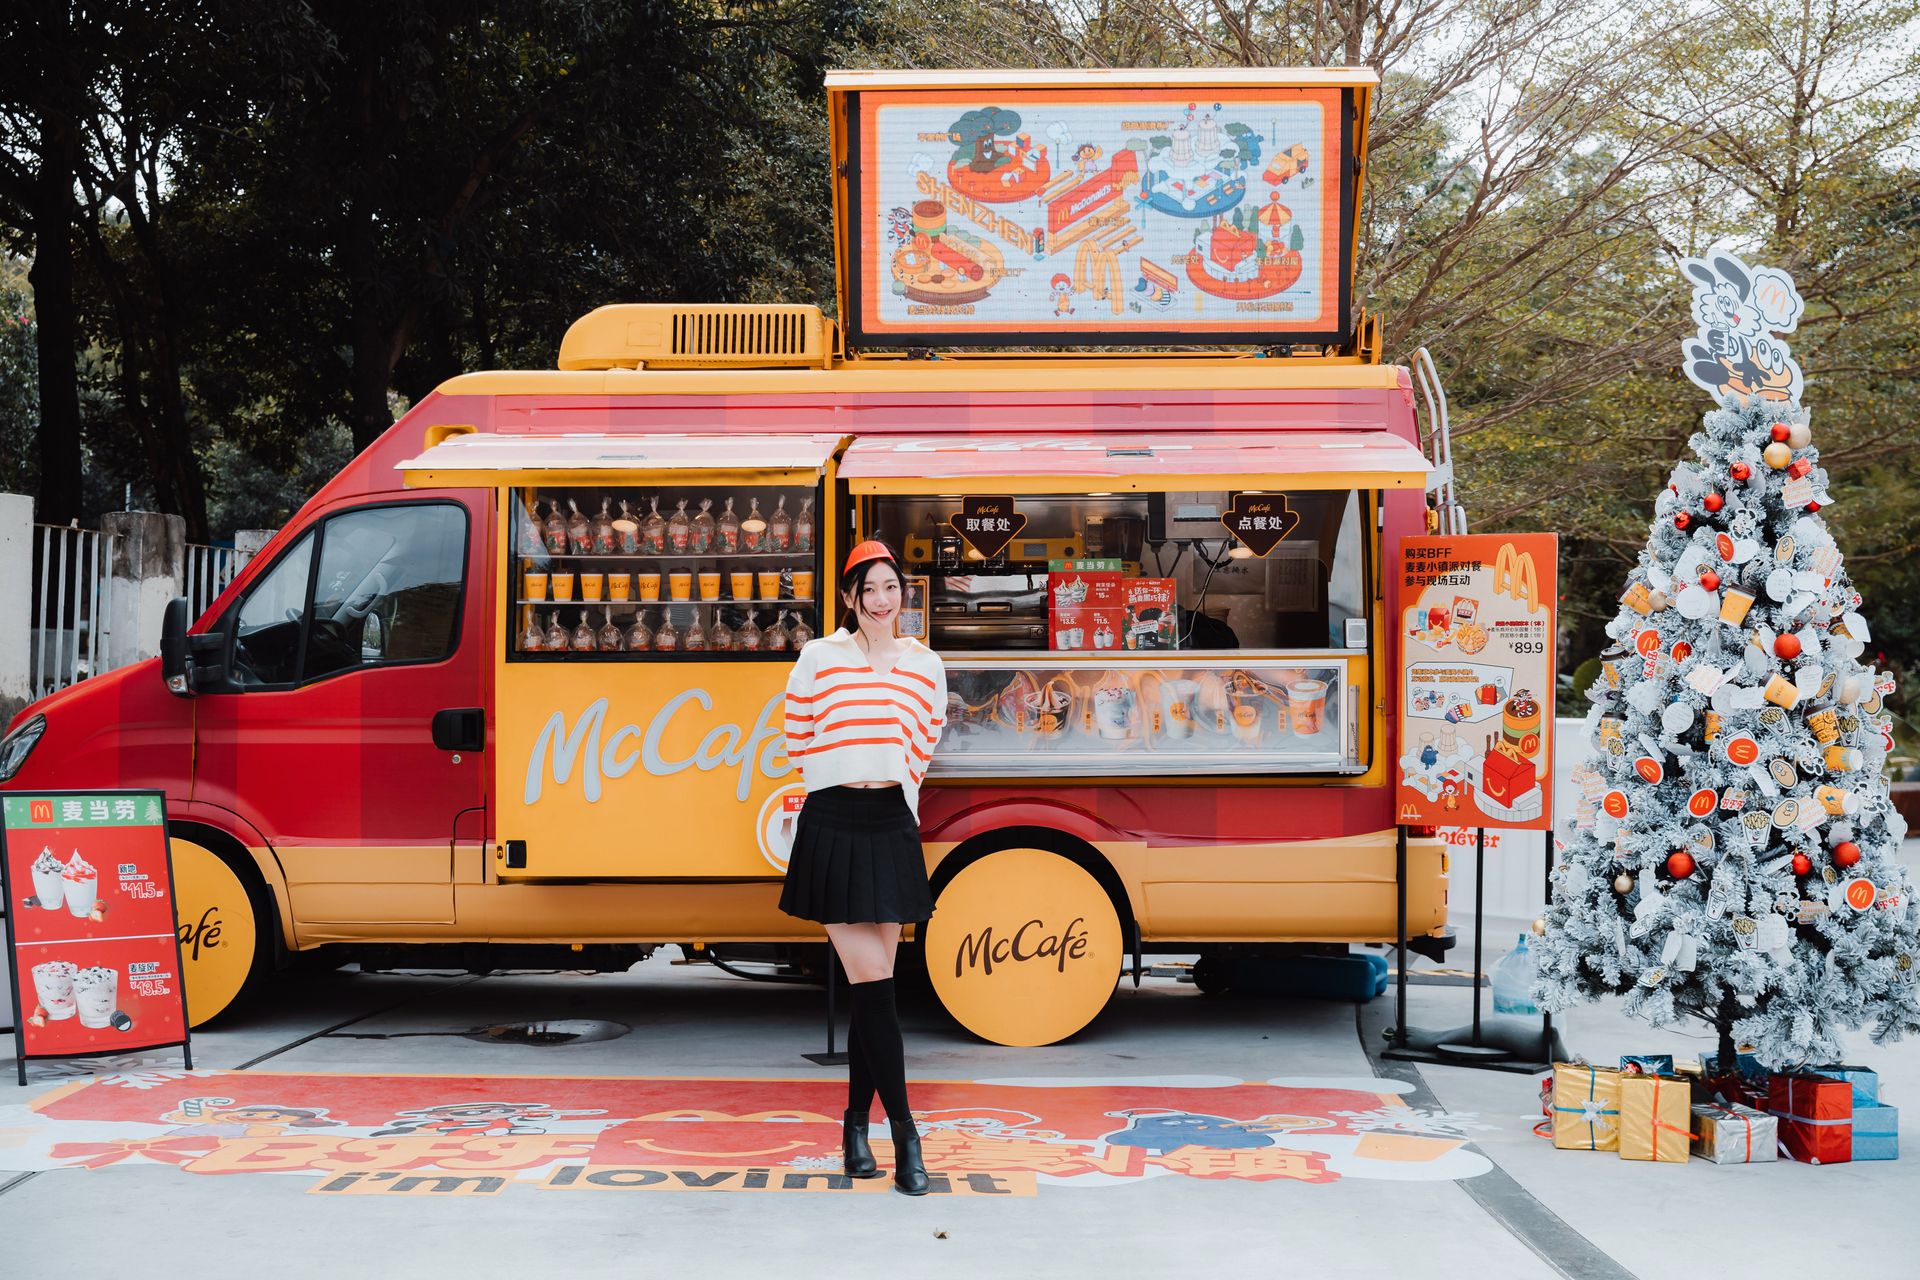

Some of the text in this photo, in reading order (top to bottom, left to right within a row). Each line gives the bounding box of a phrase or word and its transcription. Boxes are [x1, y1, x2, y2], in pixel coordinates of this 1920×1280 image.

[1070, 185, 1111, 215] McDonald's
[917, 171, 1035, 255] SHENZHEN
[966, 518, 1011, 532] 取餐处
[1238, 516, 1283, 530] 点餐处
[1405, 548, 1452, 560] 购买BFF
[1076, 561, 1106, 571] 麦当劳
[1405, 561, 1482, 573] 麦麦小镇派对餐
[1405, 575, 1471, 587] 参与现场互动
[1509, 641, 1544, 654] ¥89.9
[1721, 797, 1746, 809] BFF
[62, 799, 137, 822] 麦当劳
[178, 906, 223, 961] afé
[955, 918, 1089, 978] McCafé
[318, 1171, 506, 1193] i'm
